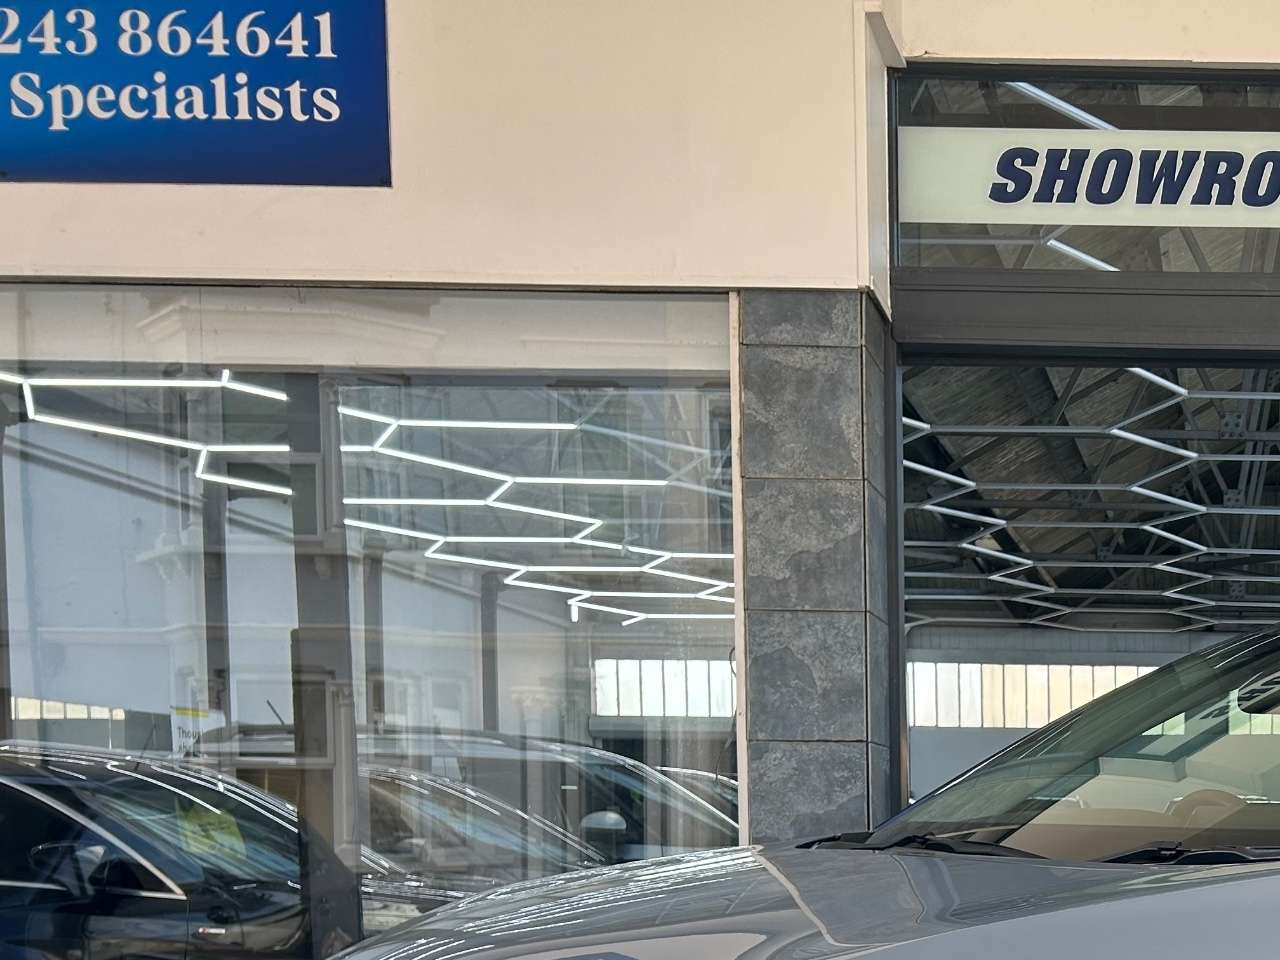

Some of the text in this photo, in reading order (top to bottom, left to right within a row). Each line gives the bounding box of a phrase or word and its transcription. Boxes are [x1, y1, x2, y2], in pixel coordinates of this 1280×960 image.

[0, 8, 337, 58] 243 864641
[10, 71, 341, 131] Specialists
